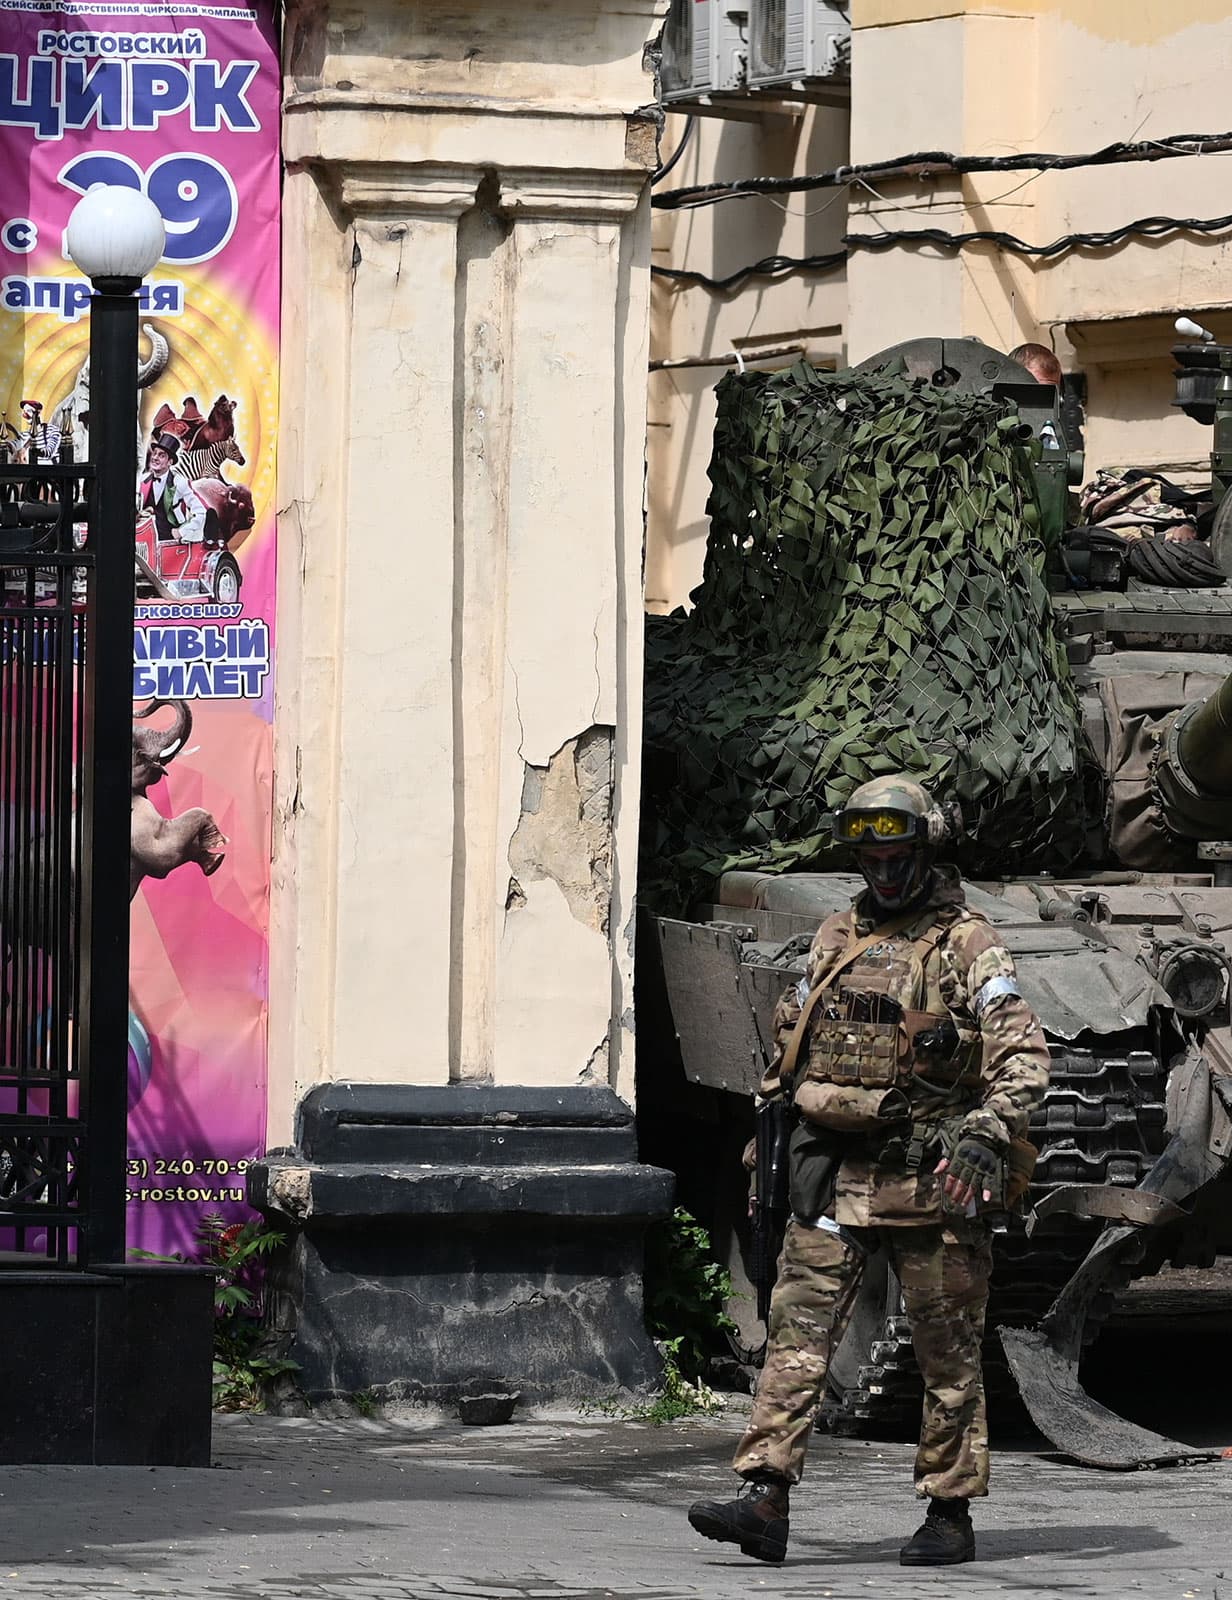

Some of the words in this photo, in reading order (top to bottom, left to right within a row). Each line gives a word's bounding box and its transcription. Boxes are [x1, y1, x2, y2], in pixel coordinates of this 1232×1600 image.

[143, 6, 198, 14] ЦИРКОВАЯ
[41, 32, 202, 55] РОСТОВСКИЙ
[0, 57, 257, 136] ЦИРК
[5, 281, 179, 317] апря
[204, 604, 241, 617] ШОУ
[134, 664, 266, 696] БИЛЕТ
